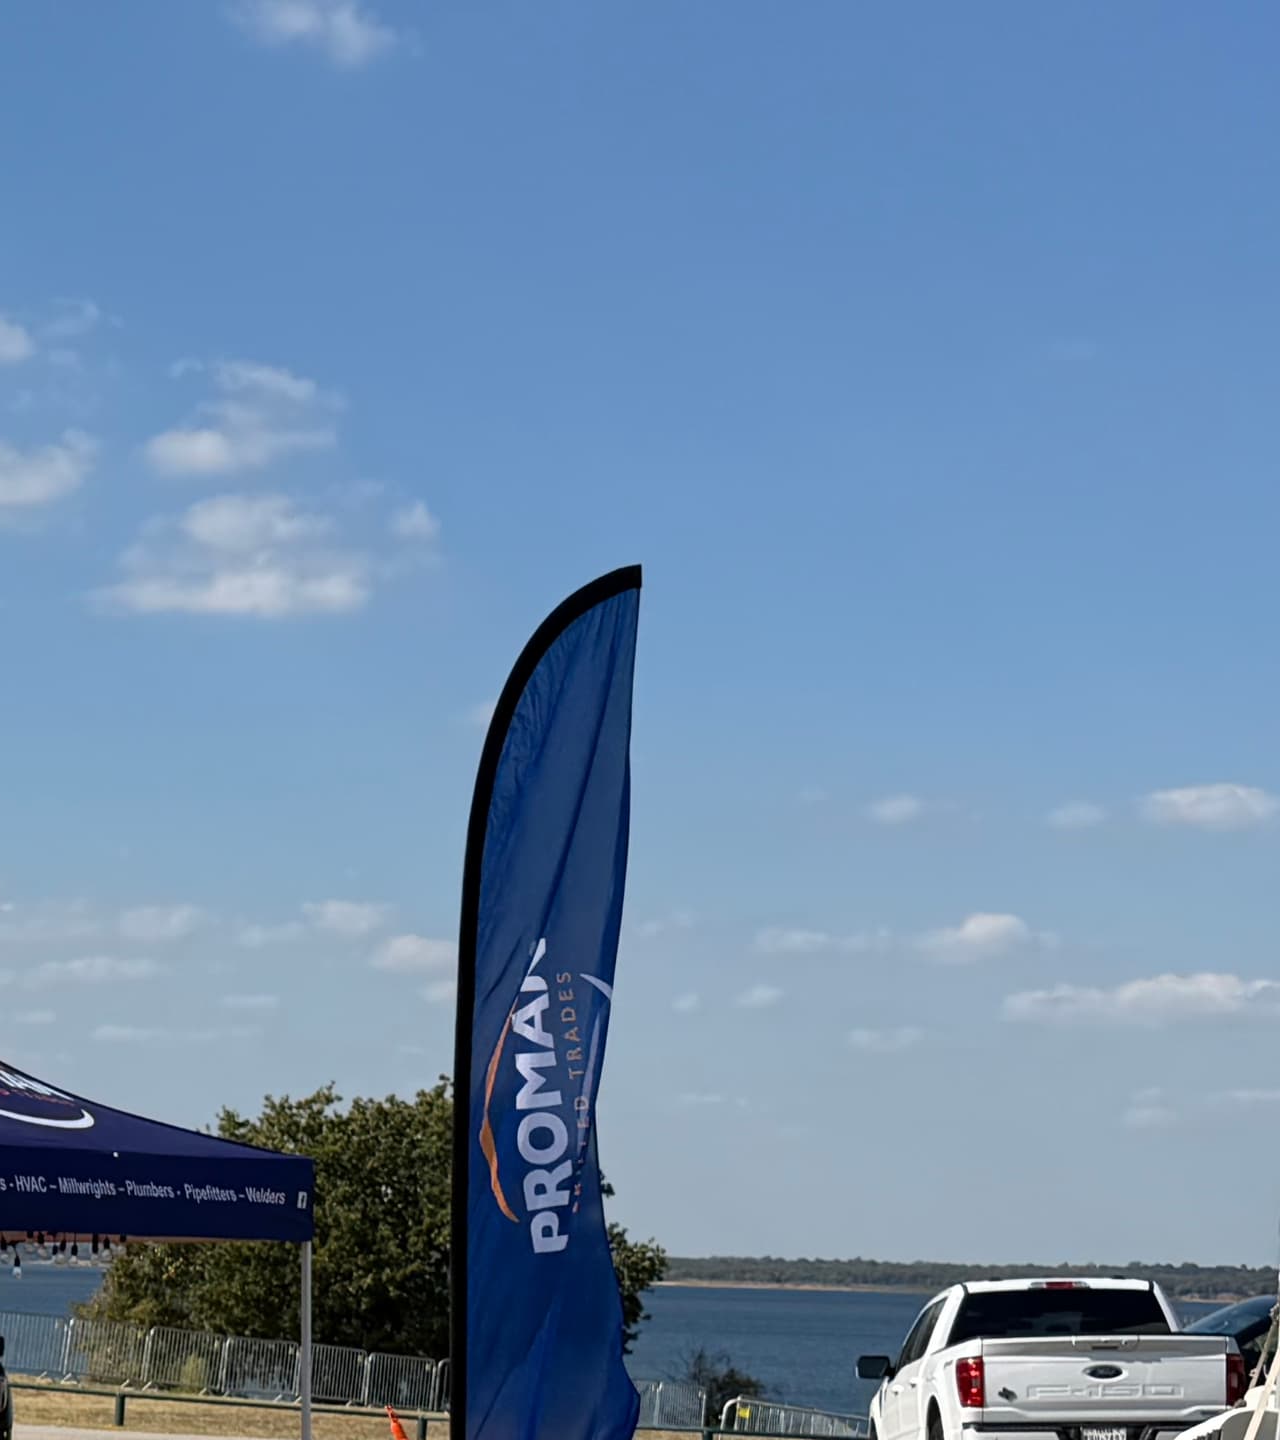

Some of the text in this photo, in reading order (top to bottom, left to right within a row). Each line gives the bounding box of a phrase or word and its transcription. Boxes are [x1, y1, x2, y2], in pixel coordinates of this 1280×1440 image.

[555, 972, 588, 1080] TRADES
[15, 1174, 47, 1193] HVAC
[58, 1176, 117, 1199] Millwrights
[125, 1179, 175, 1199] Plumbers
[183, 1183, 238, 1204] Pipefitters
[245, 1186, 286, 1205] Welders
[1027, 1384, 1185, 1399] F-150
